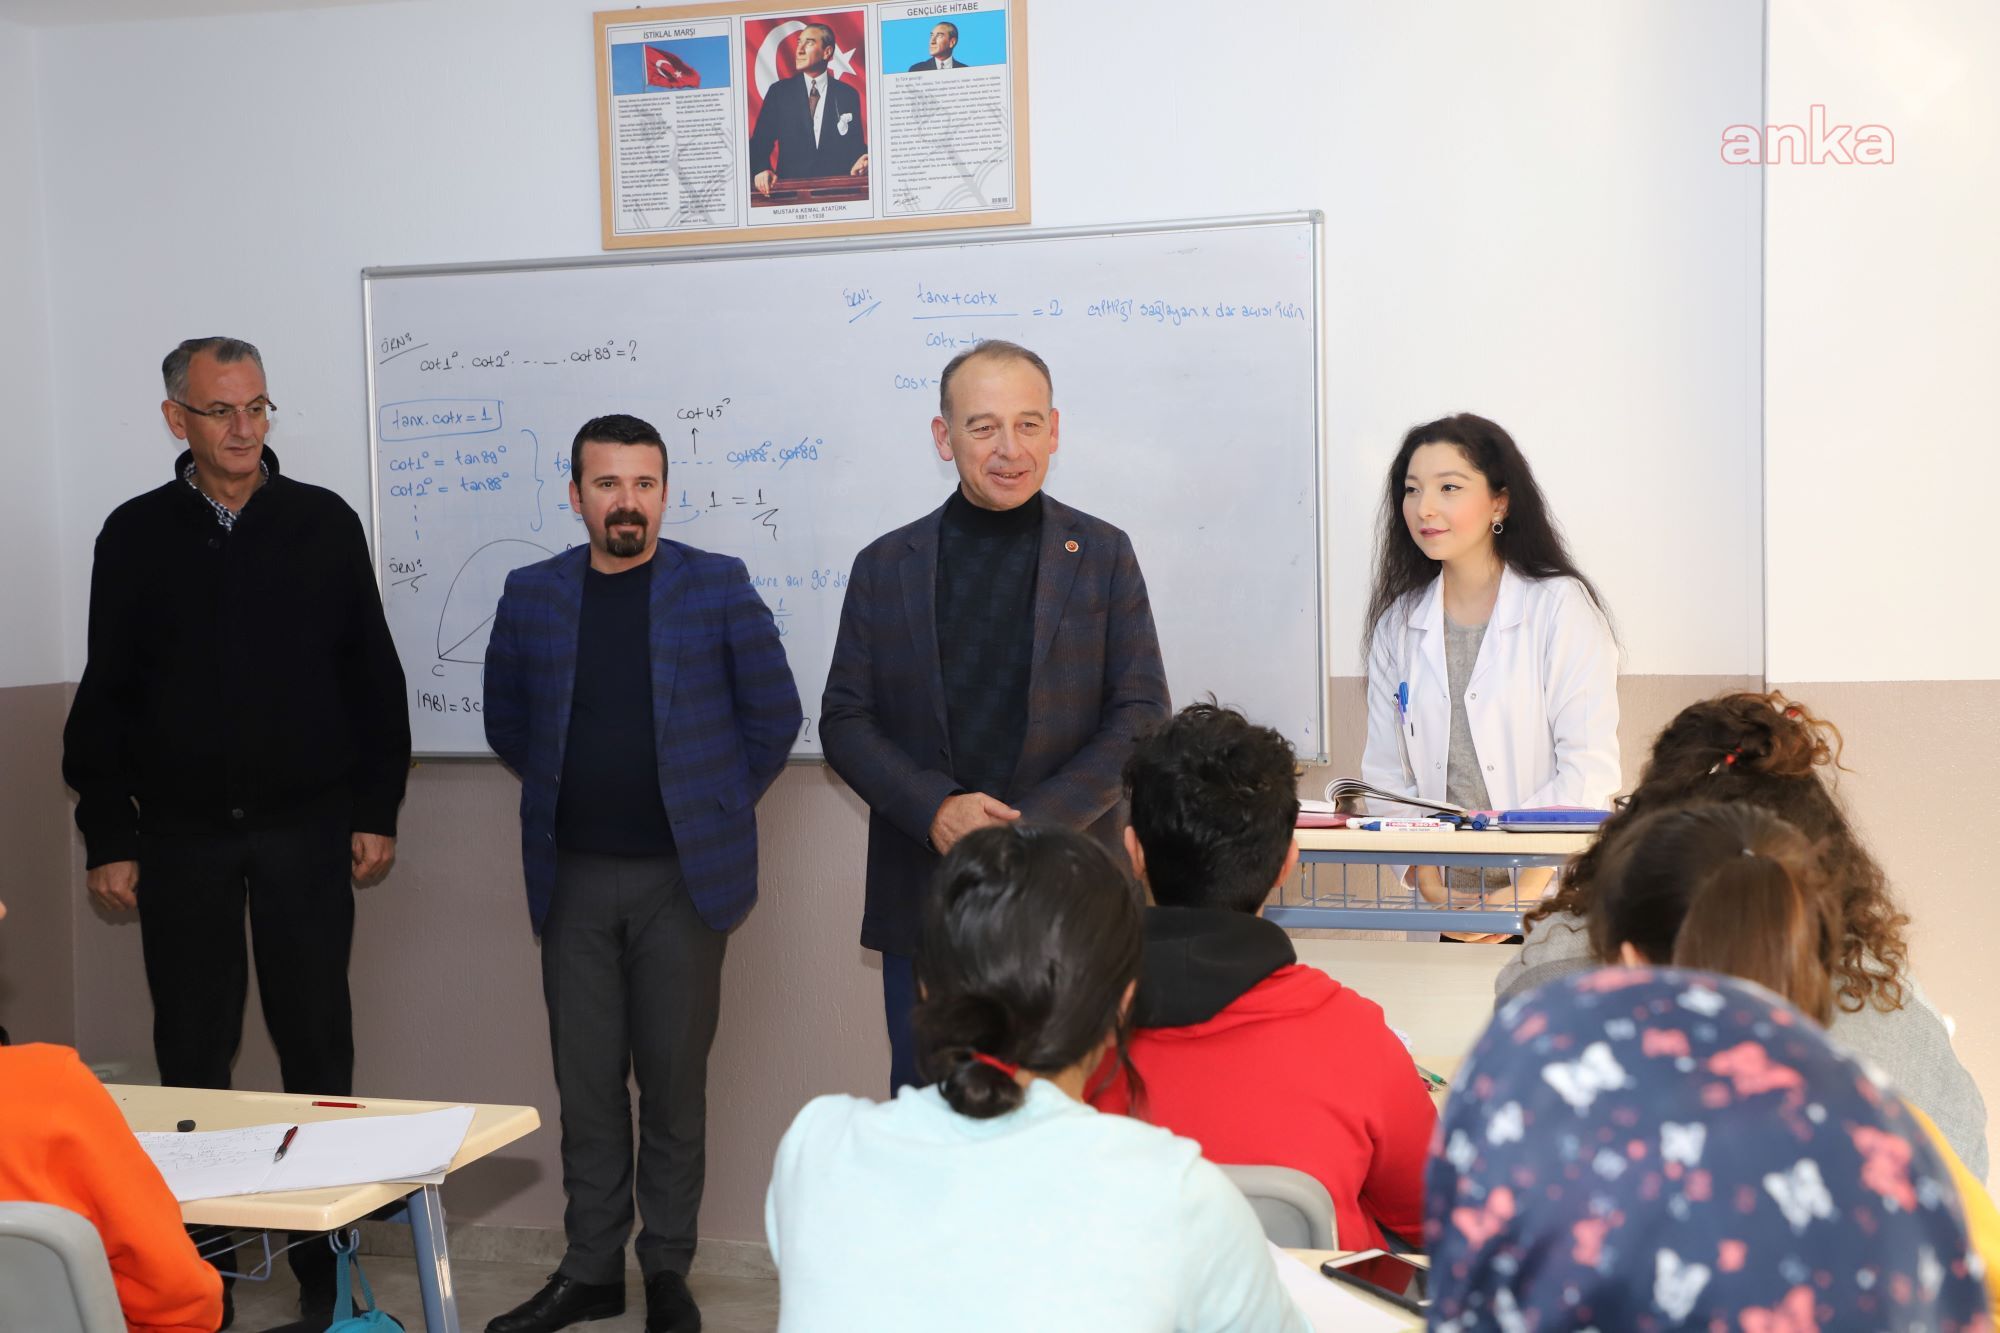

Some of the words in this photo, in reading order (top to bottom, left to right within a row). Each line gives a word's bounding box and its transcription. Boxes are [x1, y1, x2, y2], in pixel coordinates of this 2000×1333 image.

[907, 5, 948, 16] GENÇLİĞE
[949, 2, 978, 13] HİTABE
[674, 28, 696, 37] MARŞI
[1050, 300, 1063, 316] 2
[1140, 300, 1198, 326] sağlayan
[1202, 306, 1210, 317] x
[1215, 303, 1236, 318] dar
